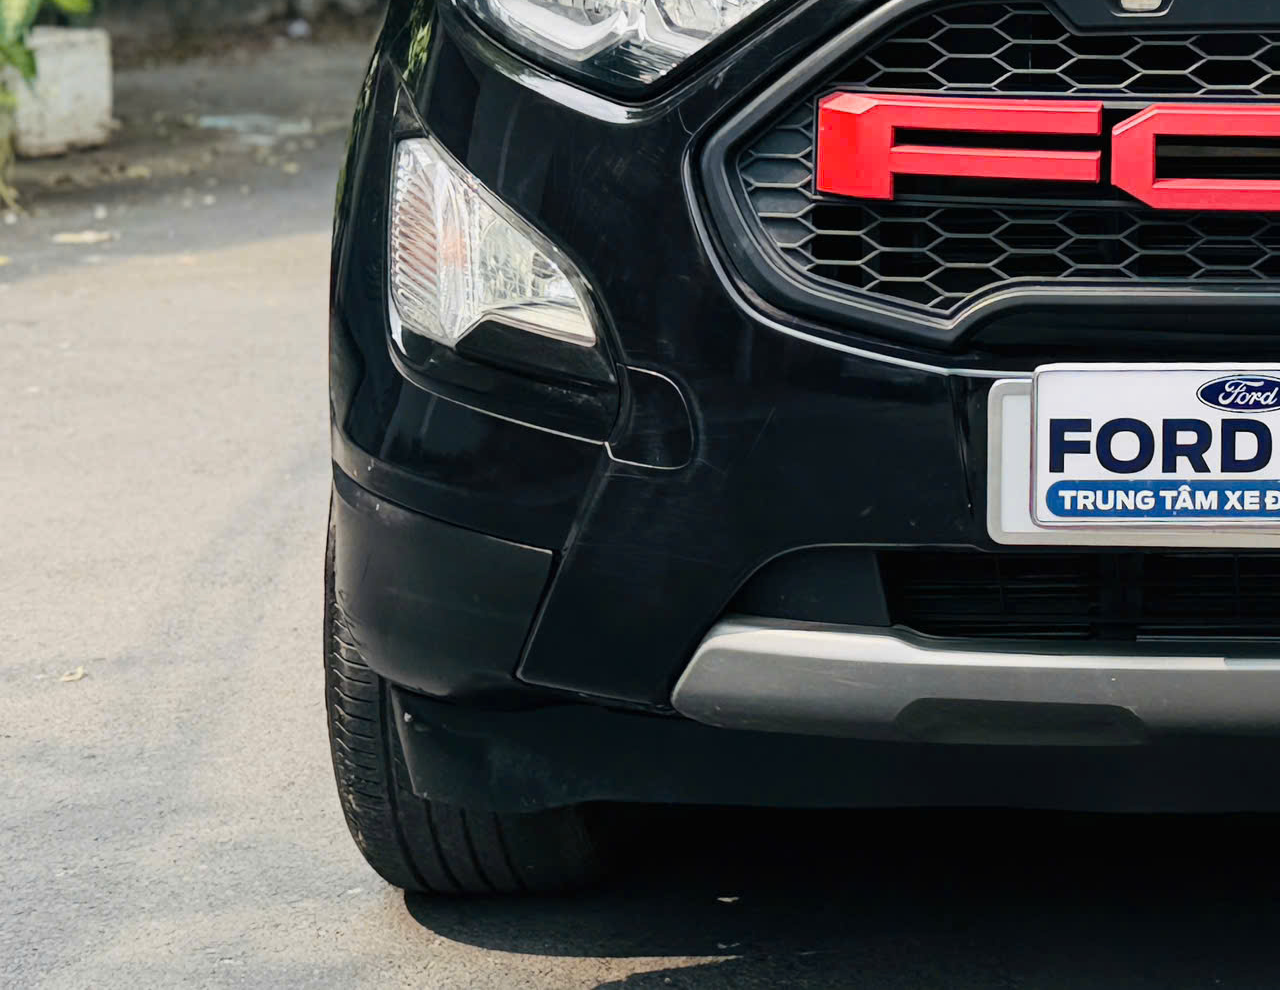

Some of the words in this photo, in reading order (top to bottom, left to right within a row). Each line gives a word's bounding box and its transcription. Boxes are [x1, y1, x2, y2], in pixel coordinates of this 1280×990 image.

[1217, 378, 1280, 407] Ford
[1049, 417, 1273, 474] FORD
[1058, 489, 1156, 511] TRUNG
[1159, 484, 1218, 511] TÂM
[1223, 489, 1260, 511] XE
